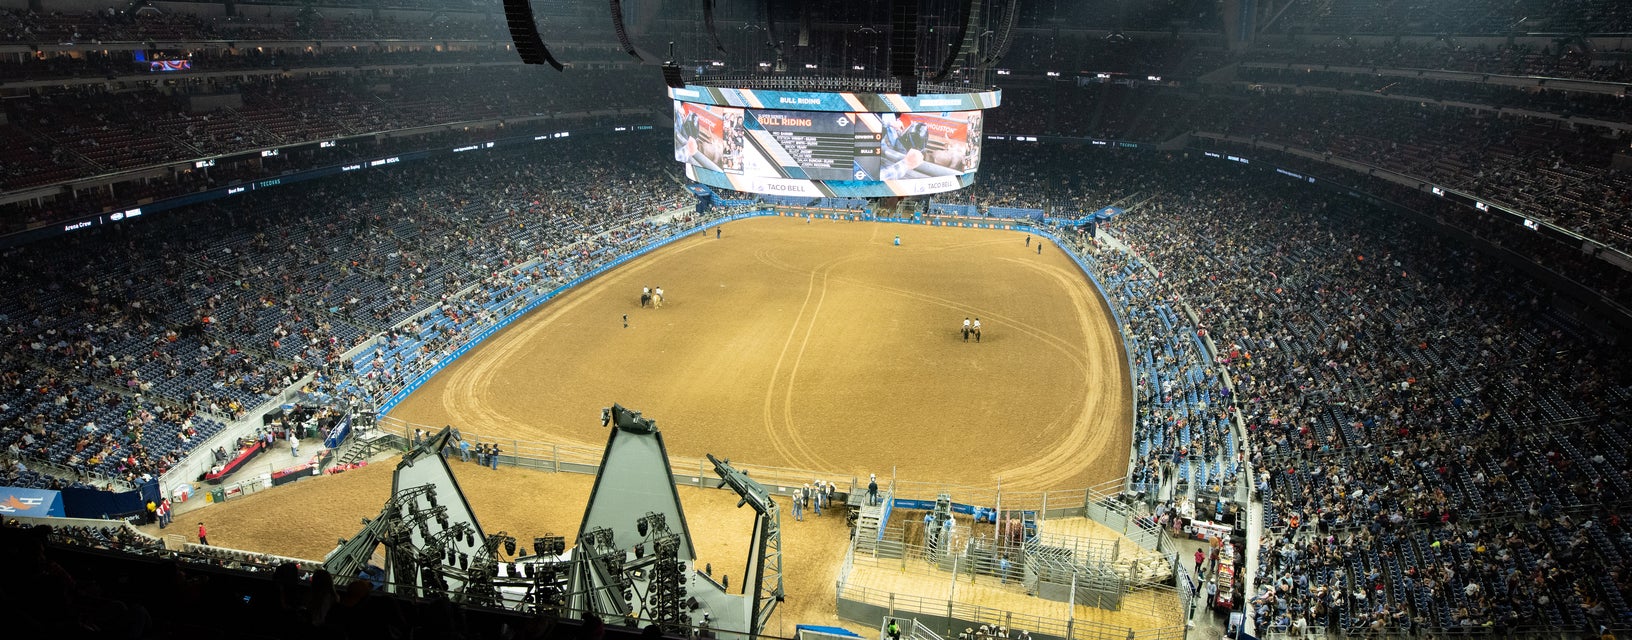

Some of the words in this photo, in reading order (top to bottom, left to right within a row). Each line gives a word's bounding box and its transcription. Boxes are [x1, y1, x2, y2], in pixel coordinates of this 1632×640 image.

[798, 97, 821, 105] RIDING
[758, 117, 779, 126] BULL
[781, 118, 812, 127] RIDING
[260, 179, 281, 187] TECOVAS
[65, 224, 79, 232] Arena
